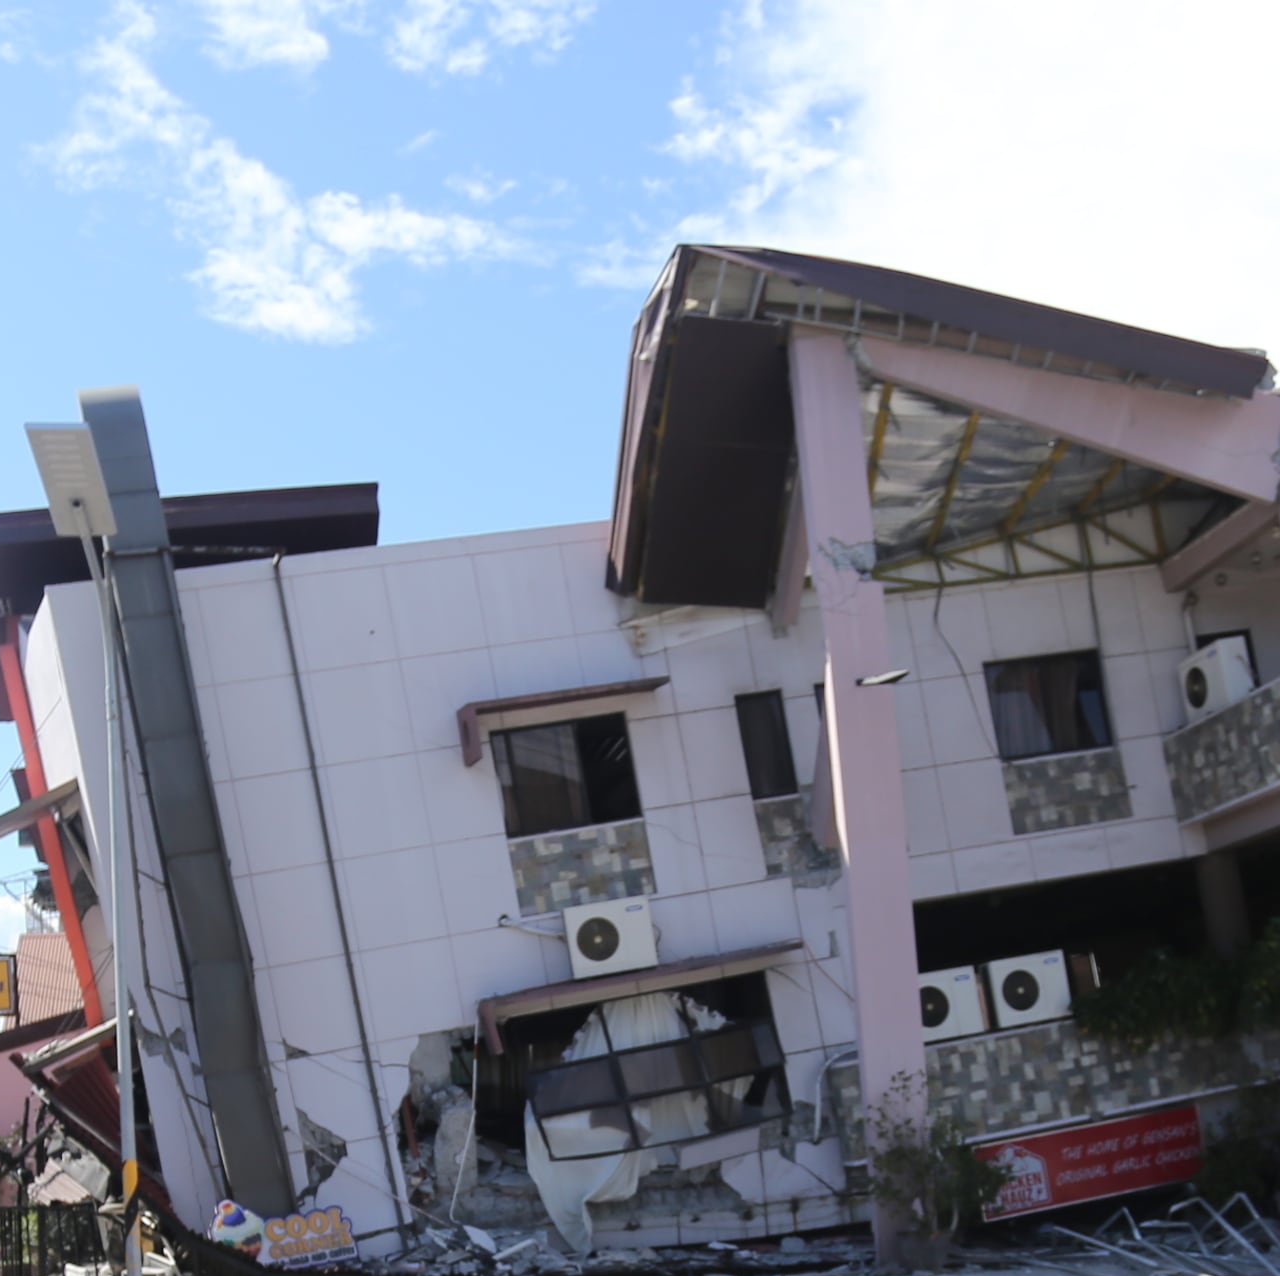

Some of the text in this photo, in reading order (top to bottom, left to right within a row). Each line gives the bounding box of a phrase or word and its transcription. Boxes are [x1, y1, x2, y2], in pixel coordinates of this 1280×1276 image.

[1062, 1145, 1084, 1161] THE
[1086, 1138, 1120, 1156] HOME
[1122, 1133, 1138, 1150] OF
[1055, 1163, 1110, 1187] ORIGINAL
[1112, 1153, 1153, 1175] GARLIC
[265, 1207, 351, 1242] COOL
[270, 1232, 353, 1259] CORNER
